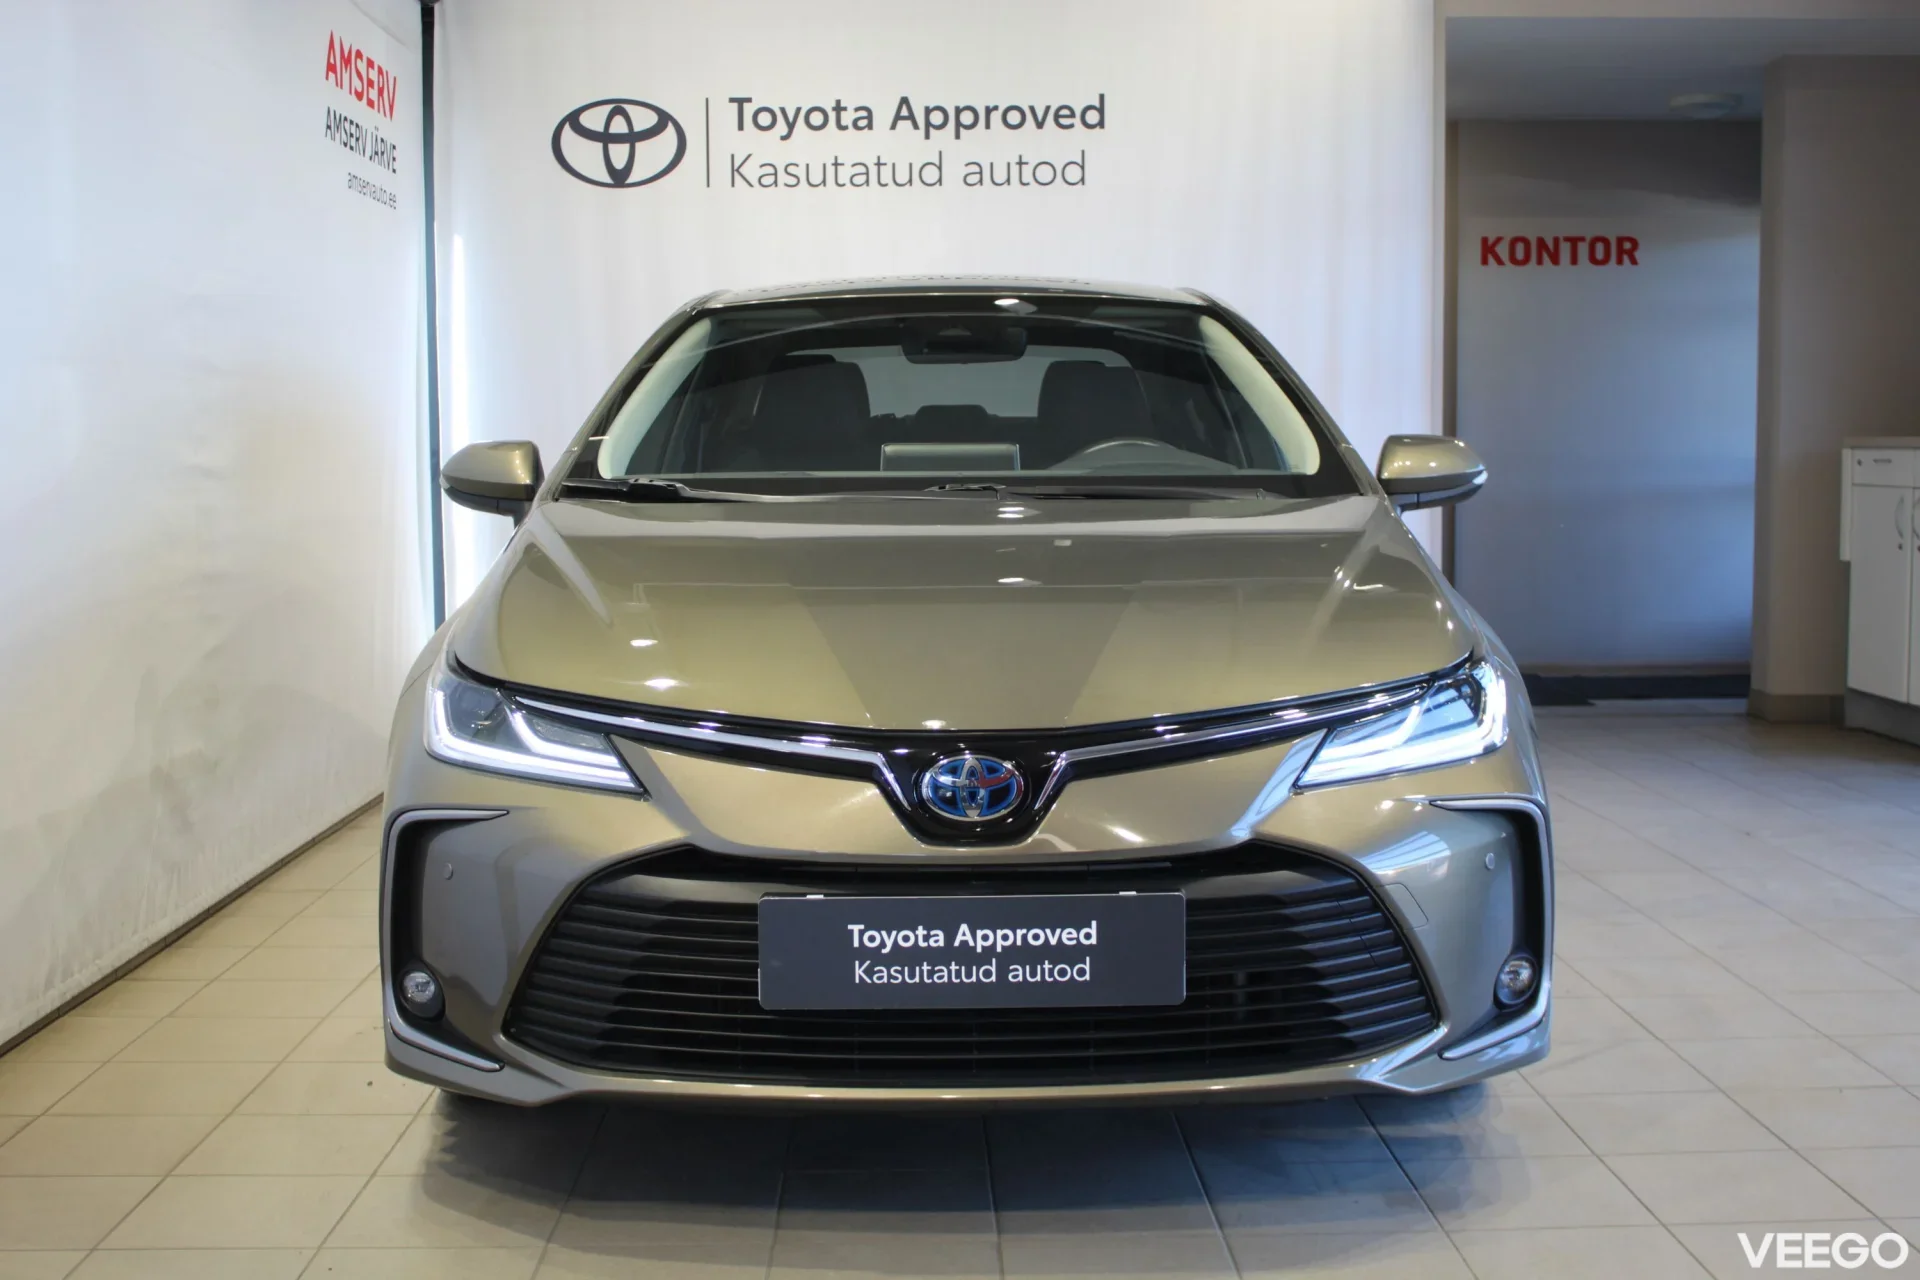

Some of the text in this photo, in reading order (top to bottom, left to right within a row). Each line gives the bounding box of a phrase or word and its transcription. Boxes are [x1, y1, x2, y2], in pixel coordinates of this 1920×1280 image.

[325, 29, 397, 122] AMSERV
[728, 93, 1107, 141] Toyota Approved
[325, 106, 397, 174] AMSERV JÄRVE
[729, 149, 1087, 189] Kasutatud autod
[347, 172, 397, 210] amservauto.ee
[1480, 235, 1640, 266] KONTOR
[847, 920, 1098, 953] Toyota Approved
[853, 956, 1091, 984] Kasutatud autod
